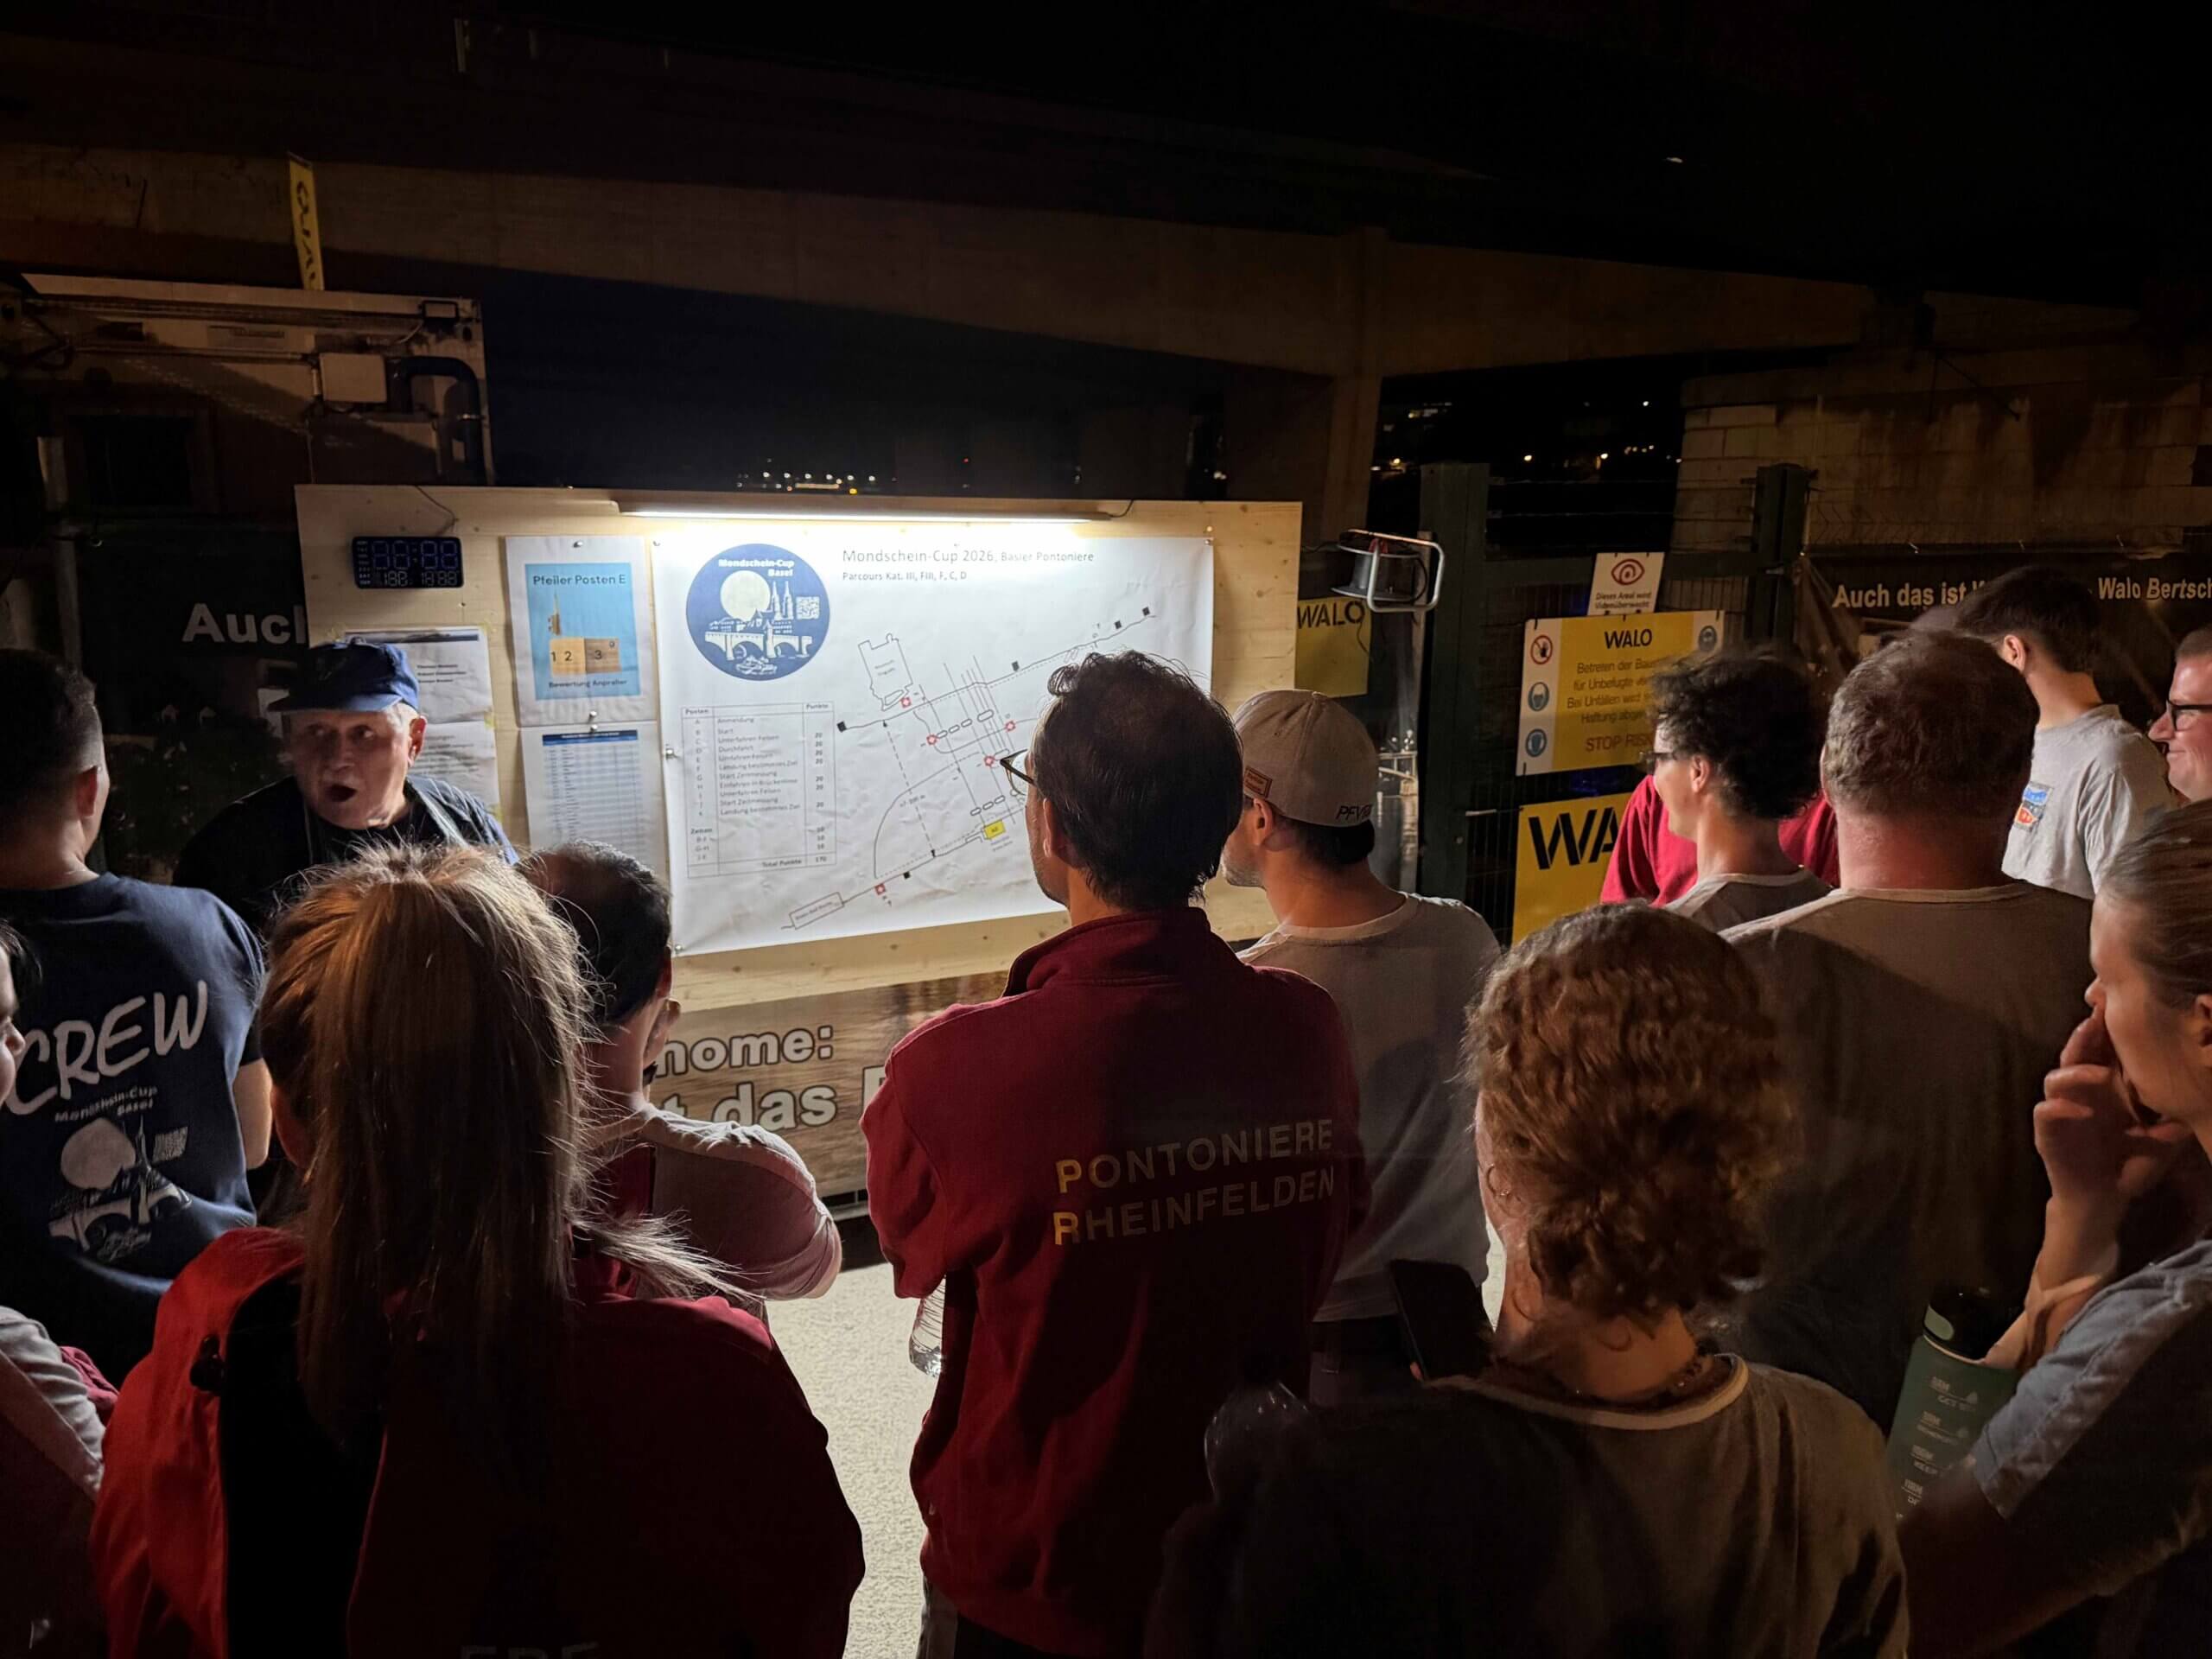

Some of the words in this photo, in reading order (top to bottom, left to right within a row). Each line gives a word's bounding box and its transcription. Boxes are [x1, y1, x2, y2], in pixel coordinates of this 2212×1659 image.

[842, 550, 957, 563] Mondschein-Cup
[962, 550, 997, 563] 2026,
[1037, 551, 1094, 562] Pontoniere
[533, 575, 572, 585] Pfeiler
[575, 575, 615, 585] Posten
[620, 575, 626, 584] E
[842, 571, 882, 581] Parcours
[960, 571, 967, 580] D
[2098, 576, 2141, 600] Walo
[1832, 582, 1891, 608] Auch
[1897, 582, 1933, 607] das
[1941, 582, 1966, 604] ist
[1297, 601, 1365, 628] WALO
[1605, 629, 1652, 648] WALO
[551, 652, 556, 662] 1
[564, 651, 572, 662] 2
[594, 650, 602, 659] 3
[1586, 734, 1621, 752] STOP
[4, 980, 207, 1115] CREW
[711, 1081, 837, 1131] das
[1055, 1119, 1333, 1194] PONTONIERE
[1052, 1165, 1335, 1246] RHEINFELDEN
